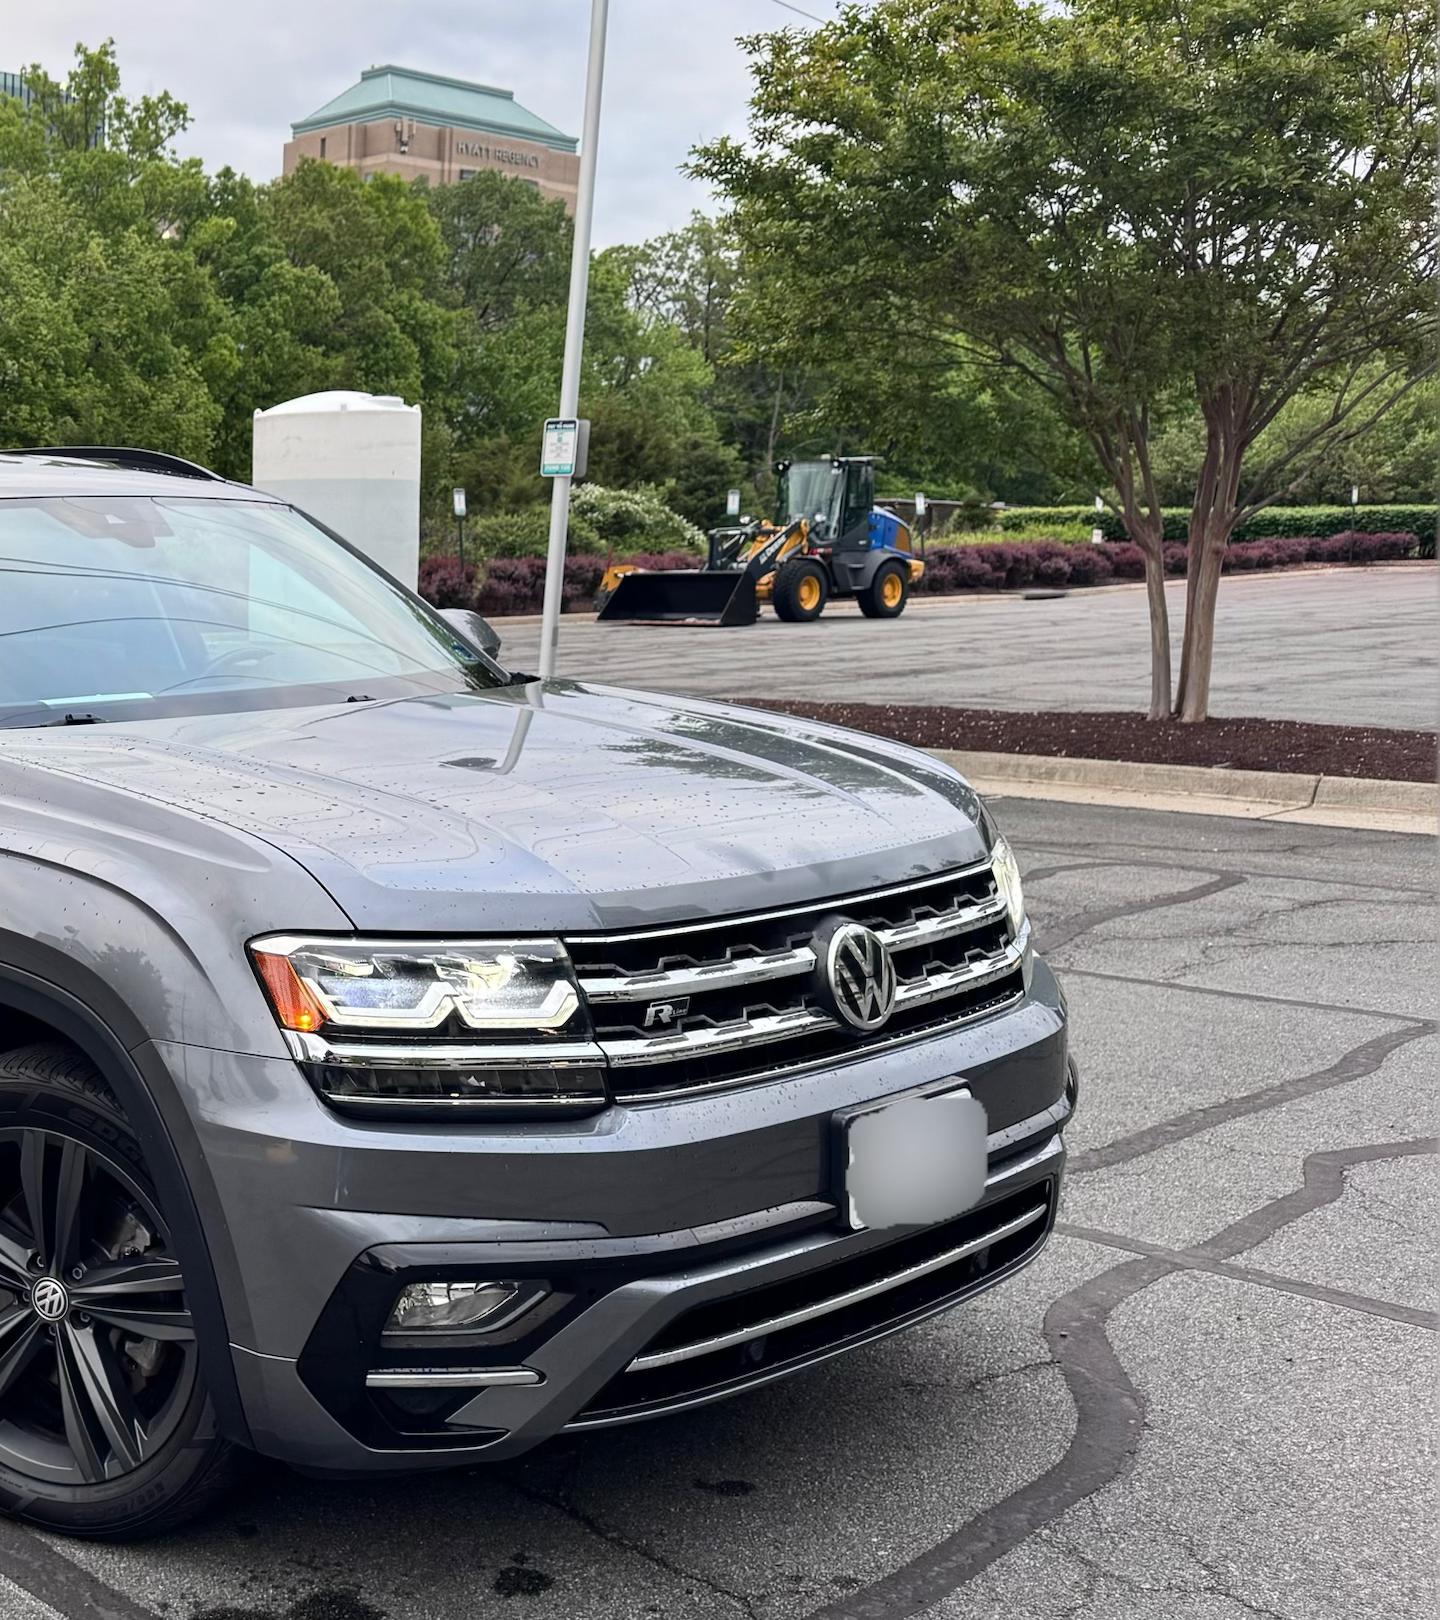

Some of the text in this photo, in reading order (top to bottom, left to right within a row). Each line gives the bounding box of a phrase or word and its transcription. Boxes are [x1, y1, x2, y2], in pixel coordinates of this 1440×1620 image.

[456, 141, 540, 169] HYATT REGENCY
[644, 1004, 673, 1027] R
